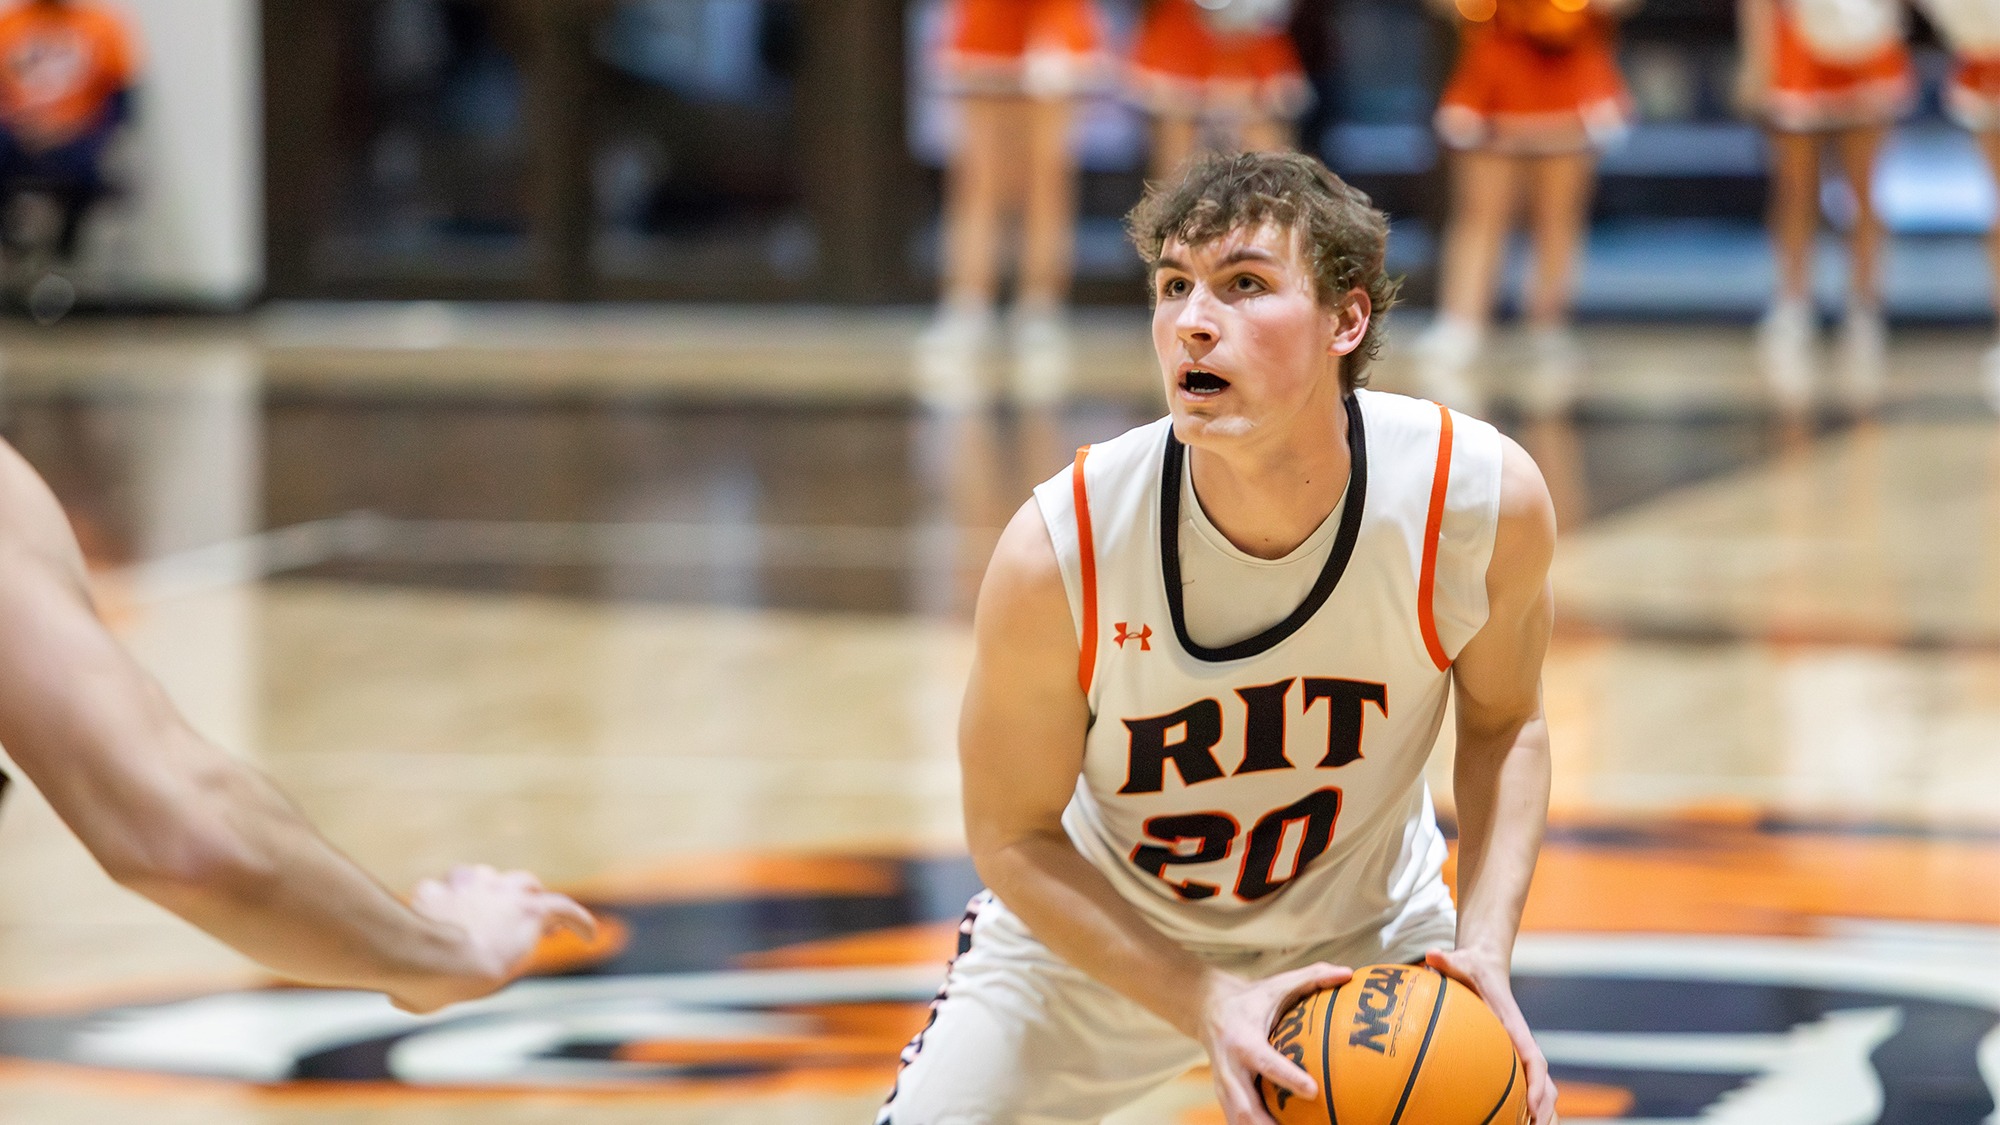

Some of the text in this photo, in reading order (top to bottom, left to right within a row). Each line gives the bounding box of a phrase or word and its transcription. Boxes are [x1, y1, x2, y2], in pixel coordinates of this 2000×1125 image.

[1116, 676, 1388, 795] RIT
[1129, 785, 1343, 903] 20
[1348, 967, 1409, 1055] NCAA
